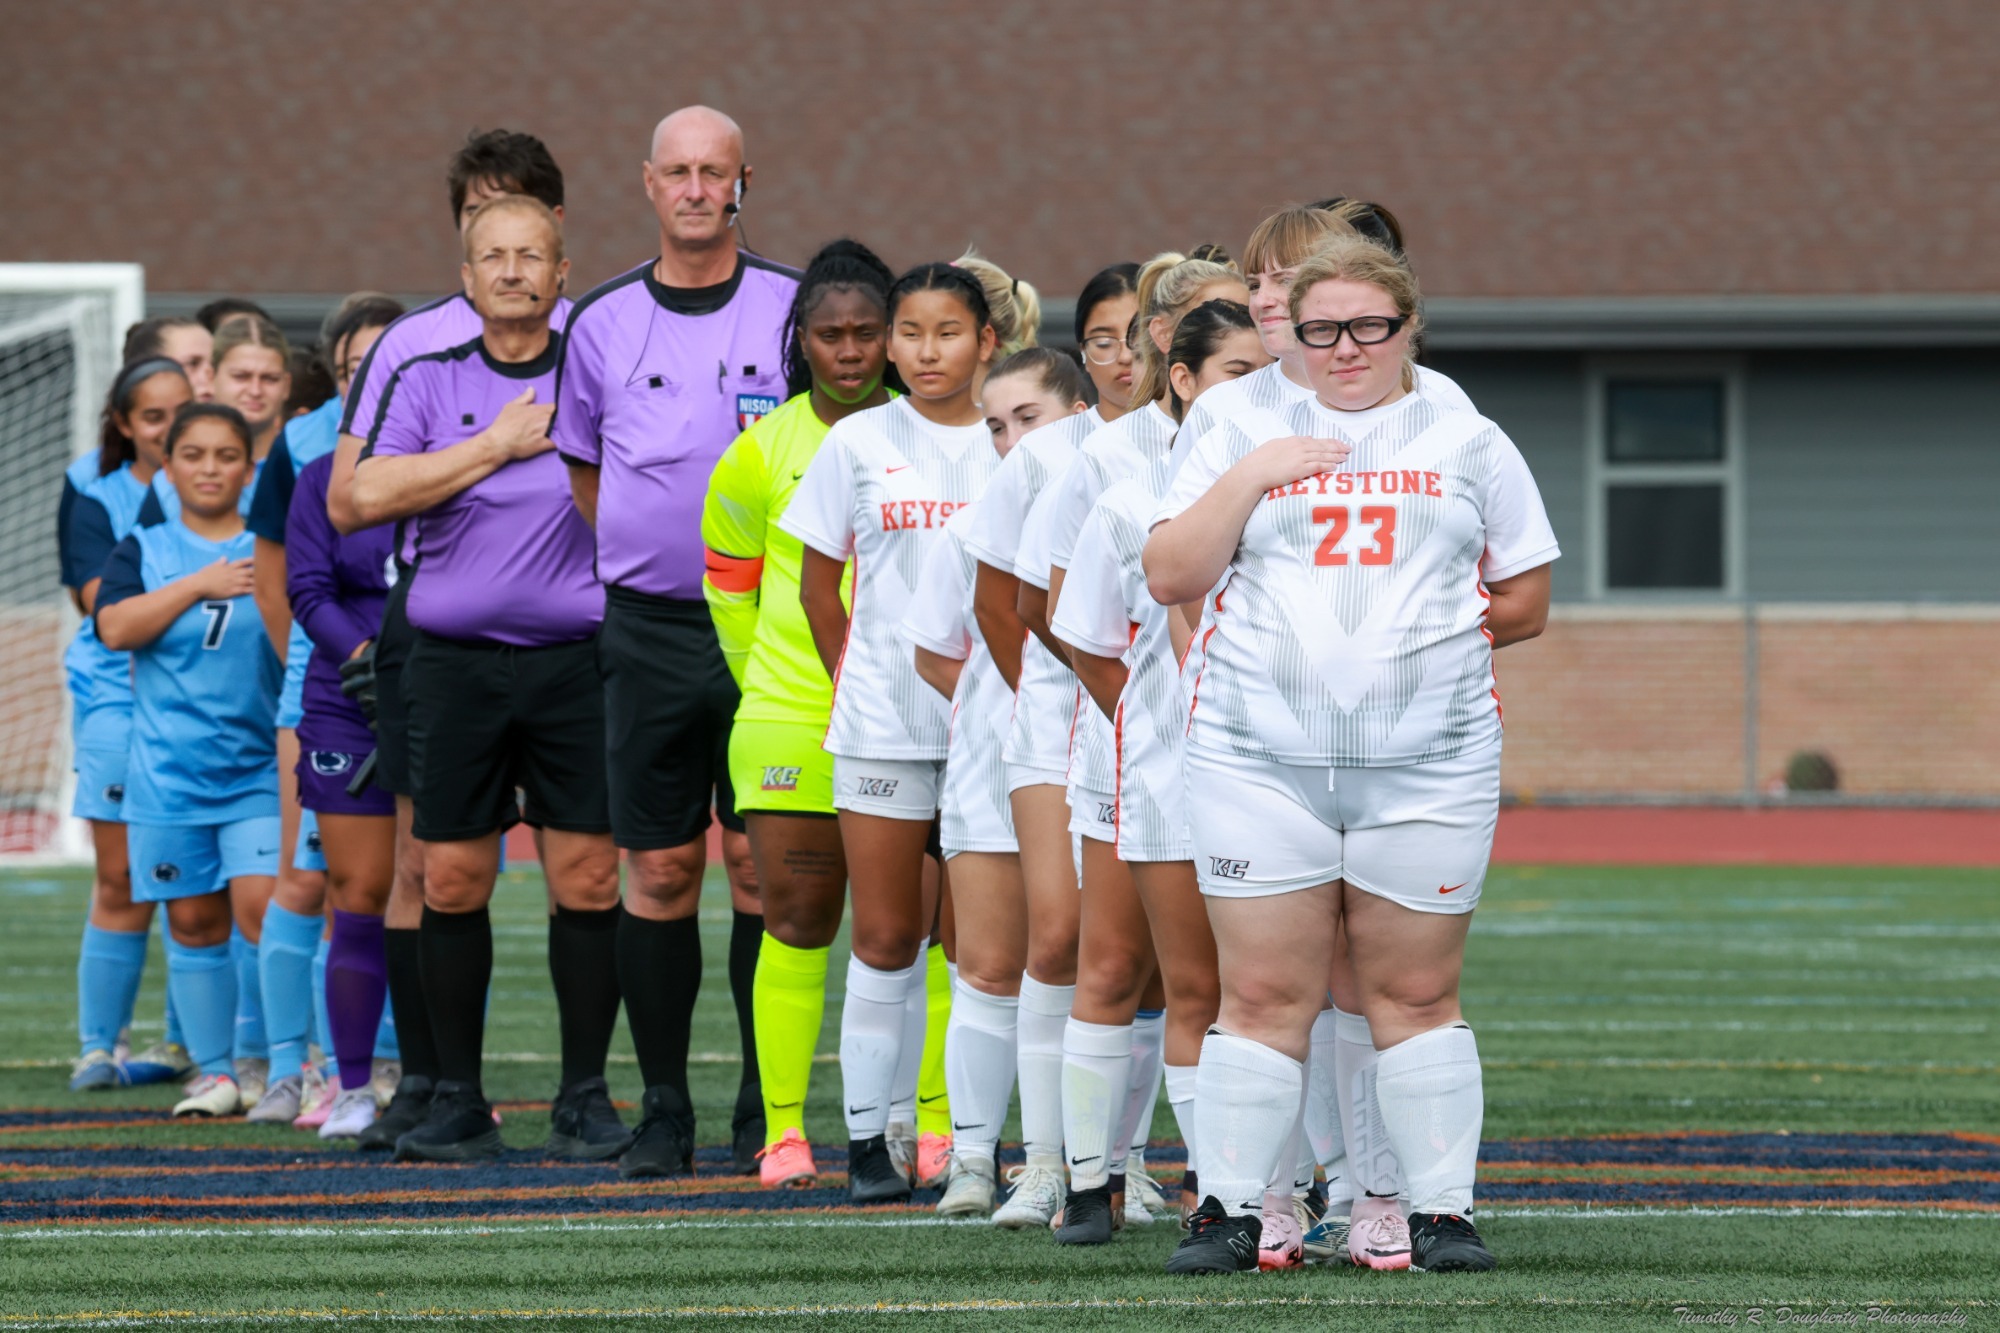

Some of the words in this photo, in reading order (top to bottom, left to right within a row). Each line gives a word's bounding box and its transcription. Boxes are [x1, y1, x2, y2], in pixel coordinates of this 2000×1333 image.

[739, 397, 776, 413] NISOA
[1311, 505, 1397, 566] 23
[201, 600, 233, 650] 7
[761, 766, 802, 786] KC
[858, 777, 898, 797] KC
[1098, 802, 1116, 824] K
[1209, 856, 1249, 879] KC
